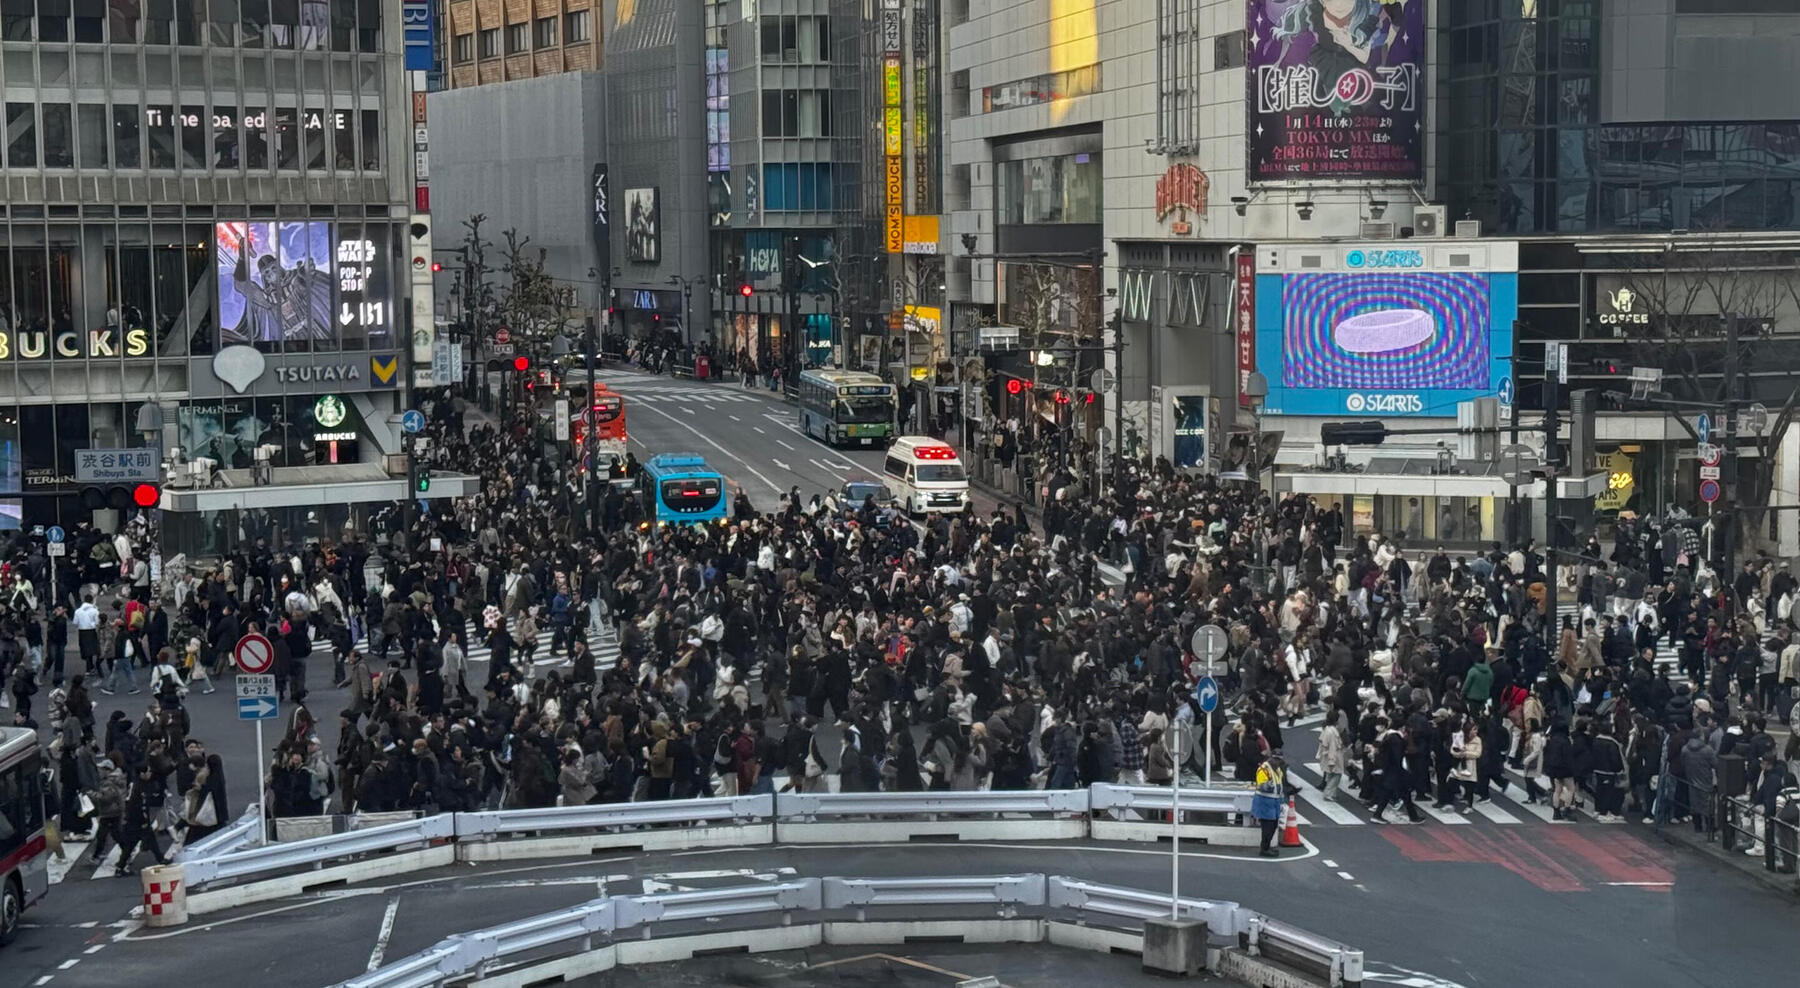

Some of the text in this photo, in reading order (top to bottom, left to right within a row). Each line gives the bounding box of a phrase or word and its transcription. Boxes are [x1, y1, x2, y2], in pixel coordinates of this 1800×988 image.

[885, 11, 898, 50] 処方せん
[1287, 131, 1343, 143] TOKYO
[890, 156, 900, 202] TOUCH
[595, 174, 607, 224] ZARA
[891, 206, 900, 250] MOM'S
[634, 290, 657, 309] ZARA
[1599, 313, 1649, 324] COFFEE
[0, 330, 147, 359] BUCKS
[276, 365, 360, 383] TSUTAYA
[1366, 395, 1423, 412] STARTS
[82, 453, 151, 468] 渋谷駅前
[93, 469, 144, 478] Shibuya Sta.
[243, 686, 268, 695] 6-22
